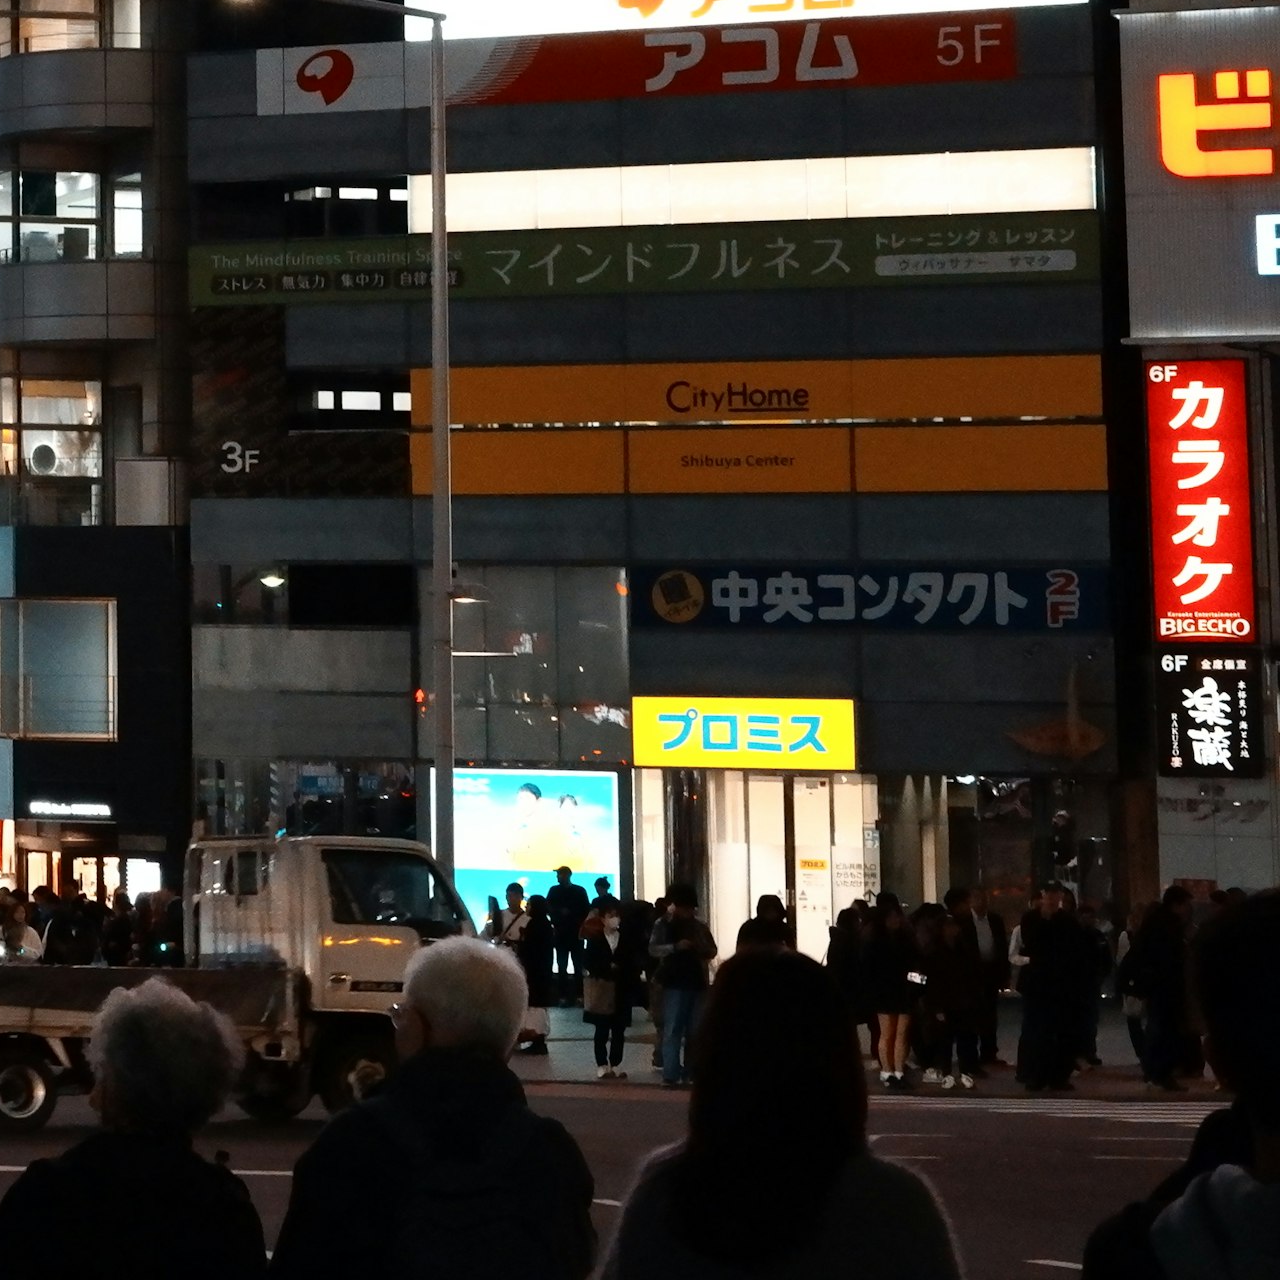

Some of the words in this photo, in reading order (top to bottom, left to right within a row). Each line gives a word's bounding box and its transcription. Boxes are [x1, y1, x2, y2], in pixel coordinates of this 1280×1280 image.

[643, 22, 860, 92] アコム
[936, 22, 1003, 67] 5F
[875, 230, 981, 250] トレーニング
[988, 231, 999, 246] &
[1004, 228, 1076, 247] レッスン
[211, 254, 240, 269] The
[245, 251, 342, 268] Mindfulness
[346, 249, 411, 268] Training
[415, 247, 463, 266] Spce
[484, 237, 852, 287] マインドフルネス
[217, 277, 267, 292] ストレス
[281, 274, 326, 291] 無気力
[341, 273, 385, 289] 集中力
[399, 270, 459, 288] 自律経
[1149, 365, 1178, 383] 6F
[665, 379, 810, 414] CityHome
[220, 440, 261, 474] 3F
[680, 452, 743, 471] Shibuya
[745, 452, 796, 469] Center
[1168, 380, 1234, 606] カラオケ
[710, 569, 1028, 626] 中央コンタクト
[1045, 568, 1080, 629] 2F
[1167, 610, 1193, 618] Karaoke
[1194, 610, 1241, 619] Entertainment
[1159, 617, 1196, 637] BIG
[1197, 617, 1251, 637] ECHO
[1161, 654, 1189, 673] 6F
[1200, 658, 1247, 671] 全席個室
[656, 708, 828, 754] プロミス
[1170, 712, 1180, 757] RAKUZO
[1181, 676, 1235, 772] 楽蔵
